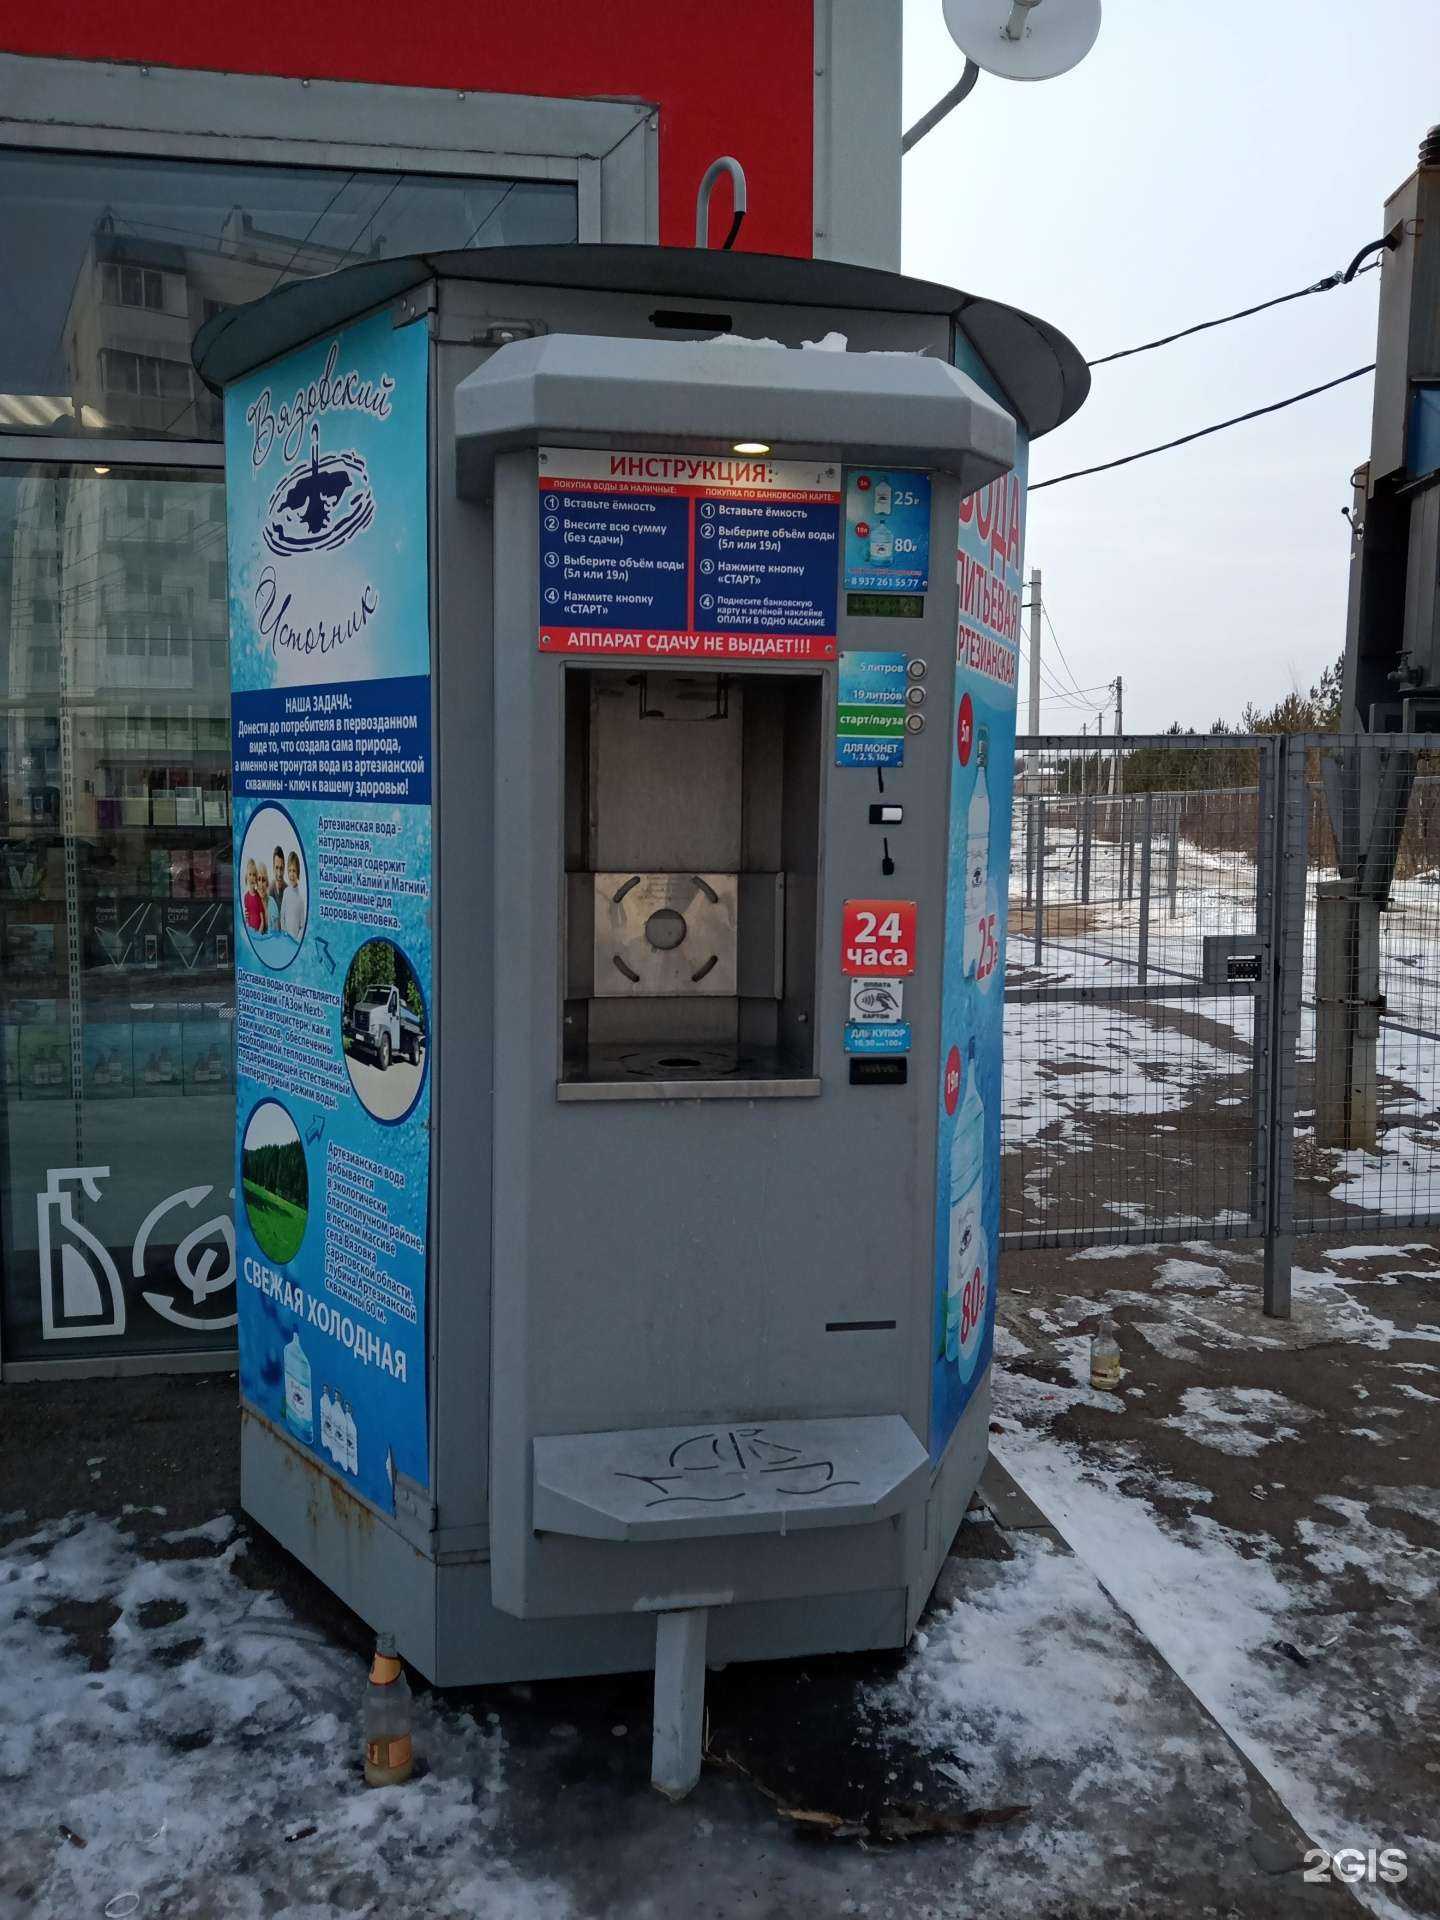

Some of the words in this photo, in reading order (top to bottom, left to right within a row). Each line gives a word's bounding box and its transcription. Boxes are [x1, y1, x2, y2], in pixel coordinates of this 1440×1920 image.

[249, 344, 391, 466] Вязовский
[610, 456, 772, 484] ИНСТРУКЦИЯ:
[554, 480, 592, 489] ПОКУПКА
[594, 482, 618, 492] ВОДЫ
[630, 485, 676, 494] НАЛИЧНЫЕ:
[705, 488, 743, 497] ПОКУПКА
[744, 489, 755, 497] ПО
[757, 489, 808, 500] БАНКОВСКОЙ
[809, 493, 835, 501] КАРТЕ:
[564, 498, 609, 510] Вставьте
[612, 500, 656, 512] ёмкость
[719, 505, 763, 516] Вставьте
[765, 507, 808, 518] ёмкость
[564, 520, 607, 530] Внесите
[609, 522, 630, 532] всю
[632, 524, 667, 535] сумму
[719, 526, 769, 538] Выберите
[772, 528, 806, 539] объём
[808, 531, 835, 542] воды
[564, 532, 586, 544] (без
[588, 533, 624, 546] сдачи)
[718, 539, 734, 550] (5л
[736, 541, 757, 550] или
[759, 540, 781, 552] 19л)
[564, 556, 616, 568] Выберите
[619, 557, 654, 569] объём
[656, 560, 685, 571] воды
[718, 562, 765, 573] Нажмите
[768, 565, 805, 576] кнопку
[564, 569, 580, 580] (5л
[583, 571, 604, 580] или
[606, 569, 629, 582] 19л)
[718, 575, 761, 585] «СТАРТ»
[858, 577, 875, 586] 937
[877, 577, 893, 587] 261
[564, 591, 613, 603] Нажмите
[615, 594, 654, 605] кнопку
[717, 596, 761, 606] Поднесите
[763, 598, 813, 608] банковскую
[255, 566, 377, 655] Источник
[564, 604, 609, 615] «СТАРТ»
[717, 608, 740, 617] карту
[749, 608, 783, 616] зелёной
[784, 609, 823, 617] наклейке
[717, 616, 751, 624] ОПЛАТИ
[753, 617, 759, 625] В
[761, 617, 786, 627] ОДНО
[787, 618, 825, 627] КАСАНИЕ
[568, 632, 642, 648] АППАРАТ
[647, 634, 700, 651] СДАЧУ
[704, 637, 725, 650] НЕ
[729, 637, 811, 655] ВЫДАЕТ!!!
[957, 625, 1015, 687] РТЕЗИАНСКАЯ
[860, 663, 866, 671] 5
[867, 664, 904, 675] литров
[285, 697, 311, 713] НАША
[313, 694, 352, 715] ЗАДАЧА:
[852, 690, 865, 699] 19
[865, 691, 903, 702] литров
[238, 721, 269, 738] Донести
[269, 721, 280, 736] до
[280, 717, 335, 737] потребителя
[336, 720, 342, 731] в
[343, 715, 418, 733] первозданном
[840, 715, 904, 727] старт/пауза
[249, 741, 268, 754] виде
[268, 741, 280, 755] то,
[280, 740, 295, 752] что
[295, 739, 330, 755] создала
[331, 739, 354, 752] сама
[355, 737, 402, 756] природа,
[843, 743, 863, 753] ДЛЯ
[864, 744, 899, 753] МОНЕТ
[240, 760, 268, 773] именно
[268, 760, 279, 772] не
[280, 760, 317, 776] тронутая
[318, 760, 341, 776] вода
[341, 760, 352, 773] из
[354, 756, 425, 778] артезианской
[245, 779, 283, 791] скважины
[289, 779, 311, 792] ключ
[311, 780, 317, 792] к
[318, 780, 354, 797] вашему
[355, 778, 409, 798] здоровью!
[318, 816, 374, 834] Артезианская
[375, 822, 397, 837] вода
[318, 837, 372, 853] натуральная,
[319, 854, 363, 870] природная
[364, 860, 406, 875] содержит
[319, 868, 356, 888] Кальций,
[356, 873, 383, 890] Калий
[384, 879, 390, 890] и
[391, 878, 430, 897] Магний,
[319, 887, 375, 906] необходимые
[376, 895, 392, 910] для
[319, 906, 357, 922] здоровья
[359, 912, 401, 928] человека.
[854, 912, 902, 944] 24
[847, 948, 908, 966] часа
[238, 968, 266, 986] Доставка
[267, 979, 284, 992] воды
[284, 983, 340, 1006] осуществляется
[239, 986, 278, 1003] водовозами
[239, 1048, 298, 1077] поддерживающей
[299, 1071, 351, 1095] естественный
[290, 1081, 315, 1100] режим
[315, 1091, 338, 1109] воды.
[328, 1141, 383, 1176] Артезианская
[384, 1171, 405, 1188] вода
[327, 1161, 374, 1190] добывается
[333, 1179, 387, 1215] экологически
[326, 1193, 388, 1233] благополучном
[389, 1225, 424, 1254] районе,
[326, 1228, 343, 1244] села
[344, 1234, 377, 1263] Вязовка
[333, 1215, 361, 1238] лесном
[362, 1227, 396, 1256] массиве
[326, 1243, 375, 1278] Саратовской
[376, 1272, 413, 1301] области.
[243, 1256, 304, 1317] СВЕЖАЯ
[325, 1259, 356, 1288] Глубина
[357, 1277, 416, 1322] Артезианской
[325, 1279, 364, 1310] скважины
[365, 1303, 377, 1318] 60
[377, 1310, 387, 1323] м.
[307, 1294, 407, 1383] ХОЛОДНАЯ
